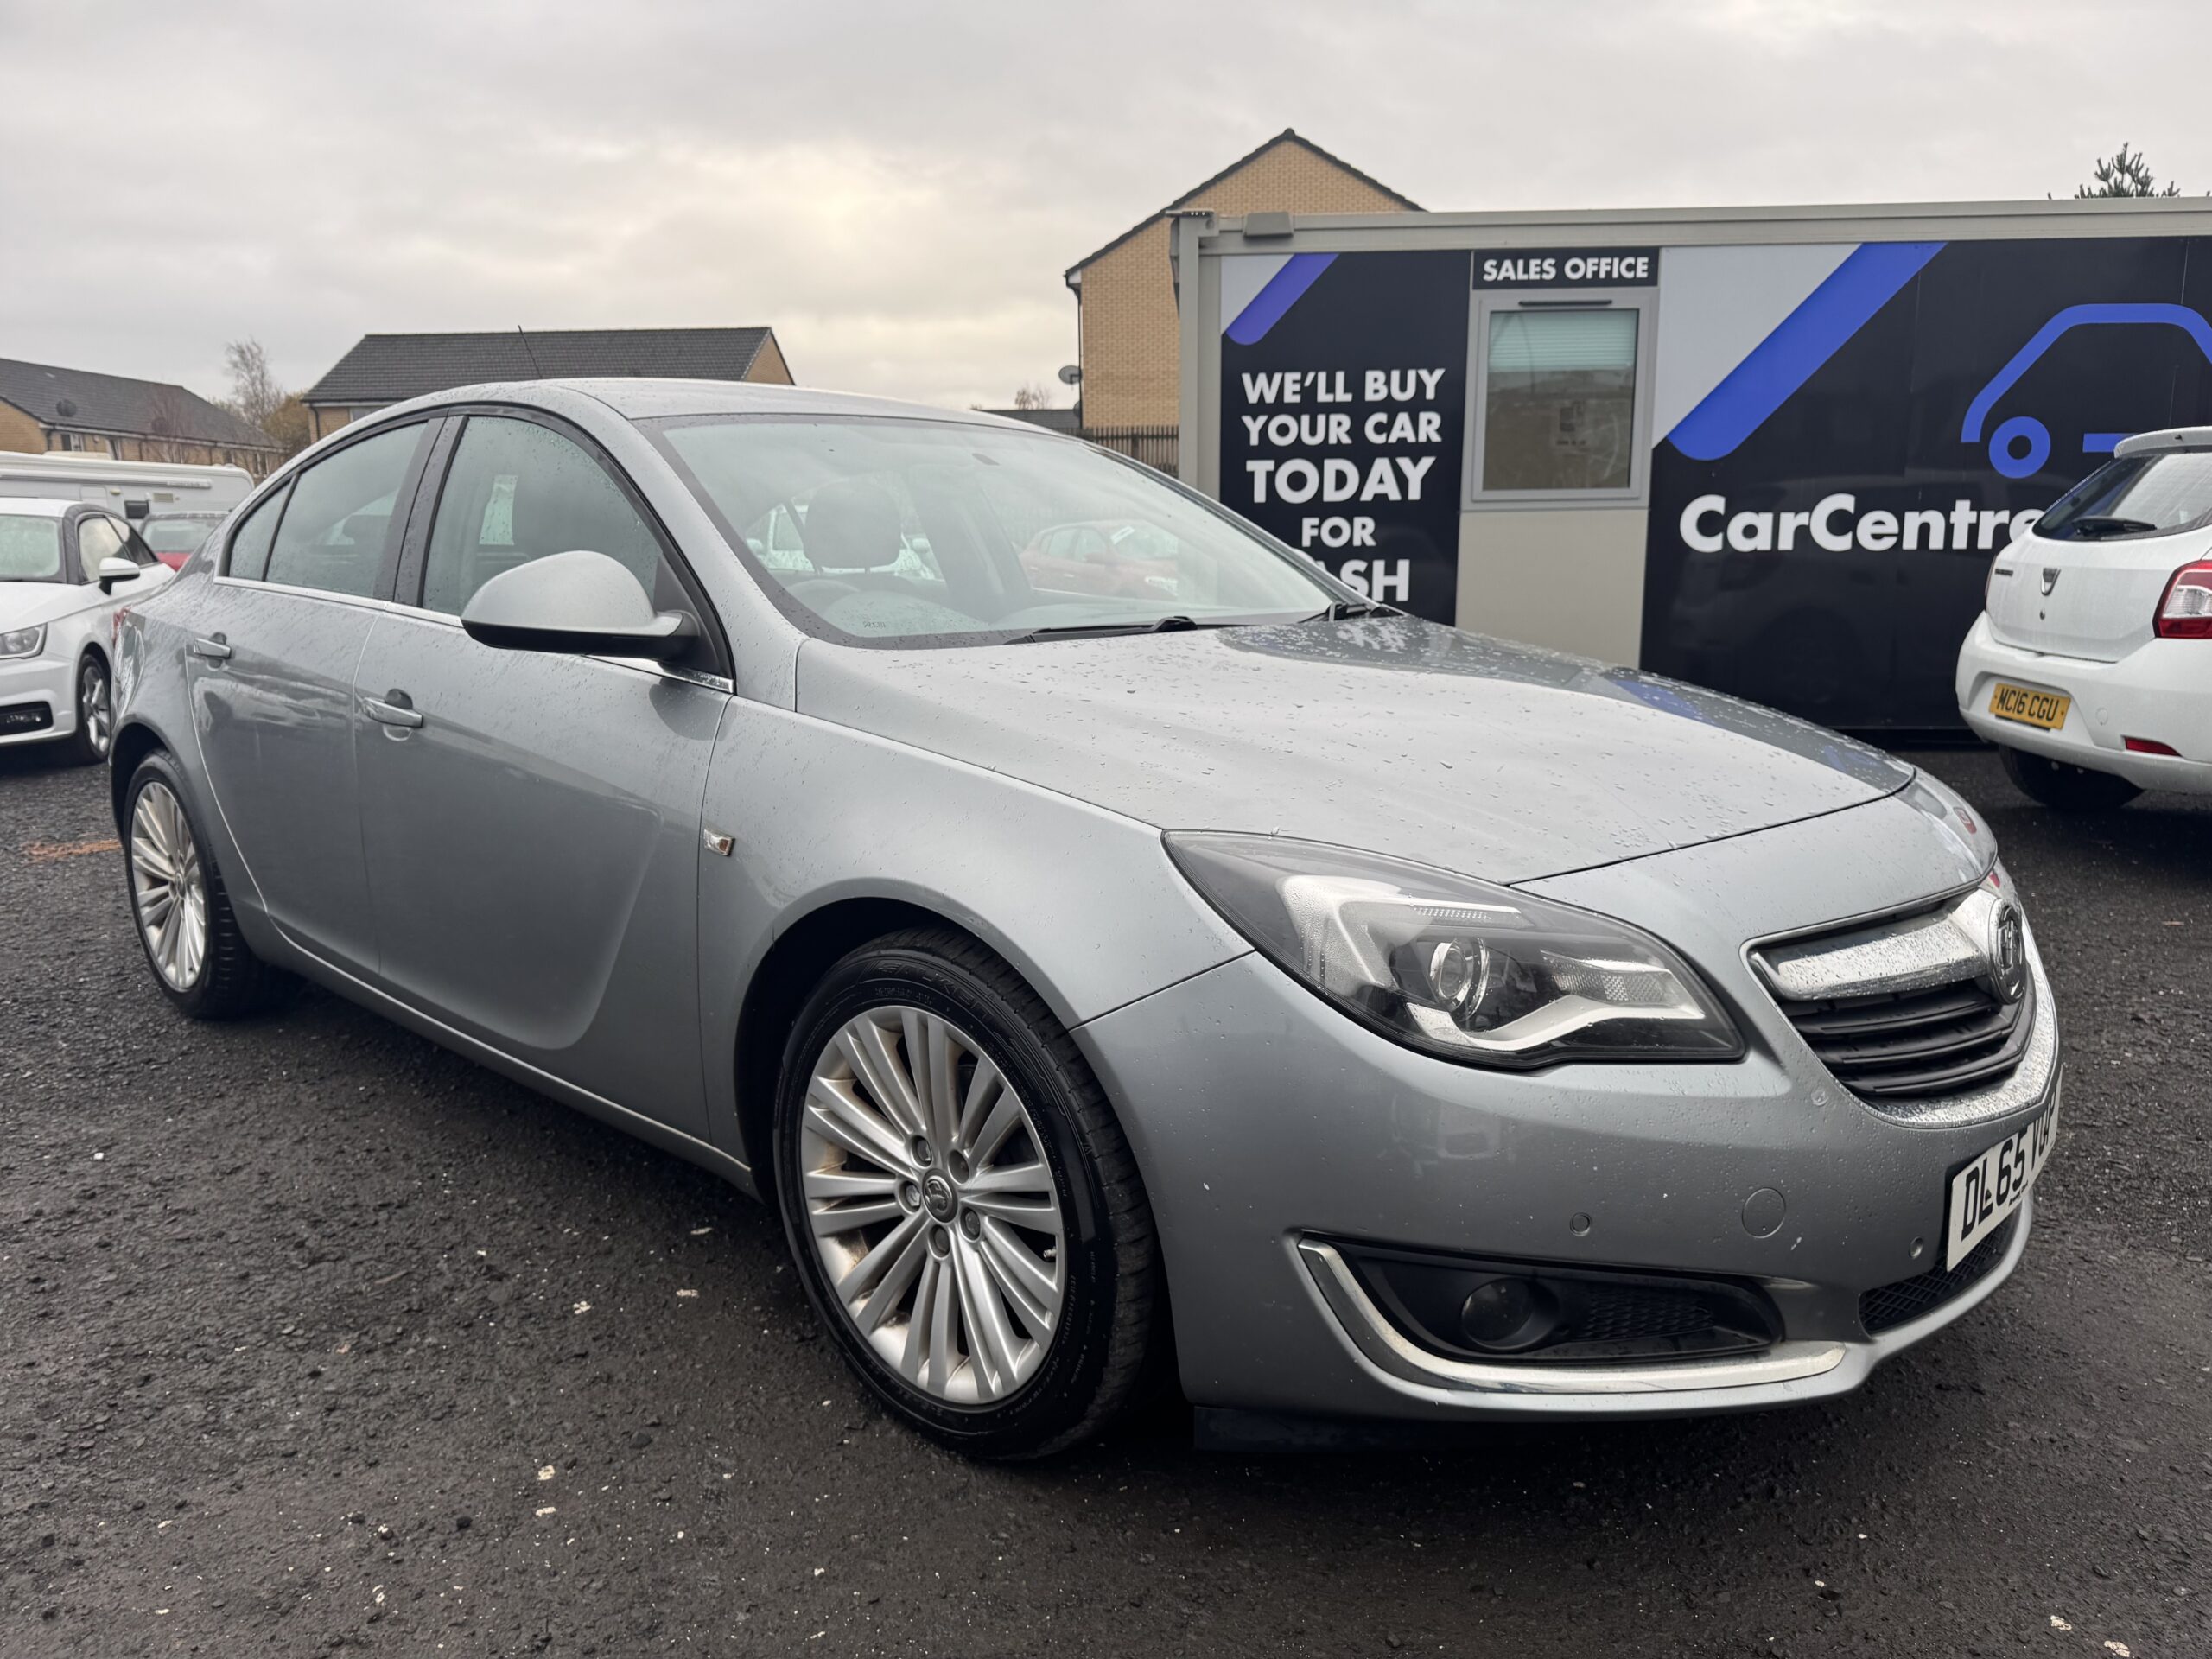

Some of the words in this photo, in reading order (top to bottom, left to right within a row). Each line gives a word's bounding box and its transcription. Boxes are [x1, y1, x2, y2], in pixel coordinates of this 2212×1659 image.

[1483, 258, 1556, 282] SALES
[1564, 257, 1649, 280] OFFICE
[1242, 371, 1352, 404] WE’LL
[1364, 368, 1446, 402] BUY
[1241, 413, 1352, 447] YOUR
[1364, 411, 1442, 444] CAR
[1246, 456, 1436, 505] TODAY
[1301, 516, 1376, 548] FOR
[1293, 548, 1410, 602] SH
[2028, 695, 2060, 721] CGU
[1961, 1127, 2028, 1242] DL65
